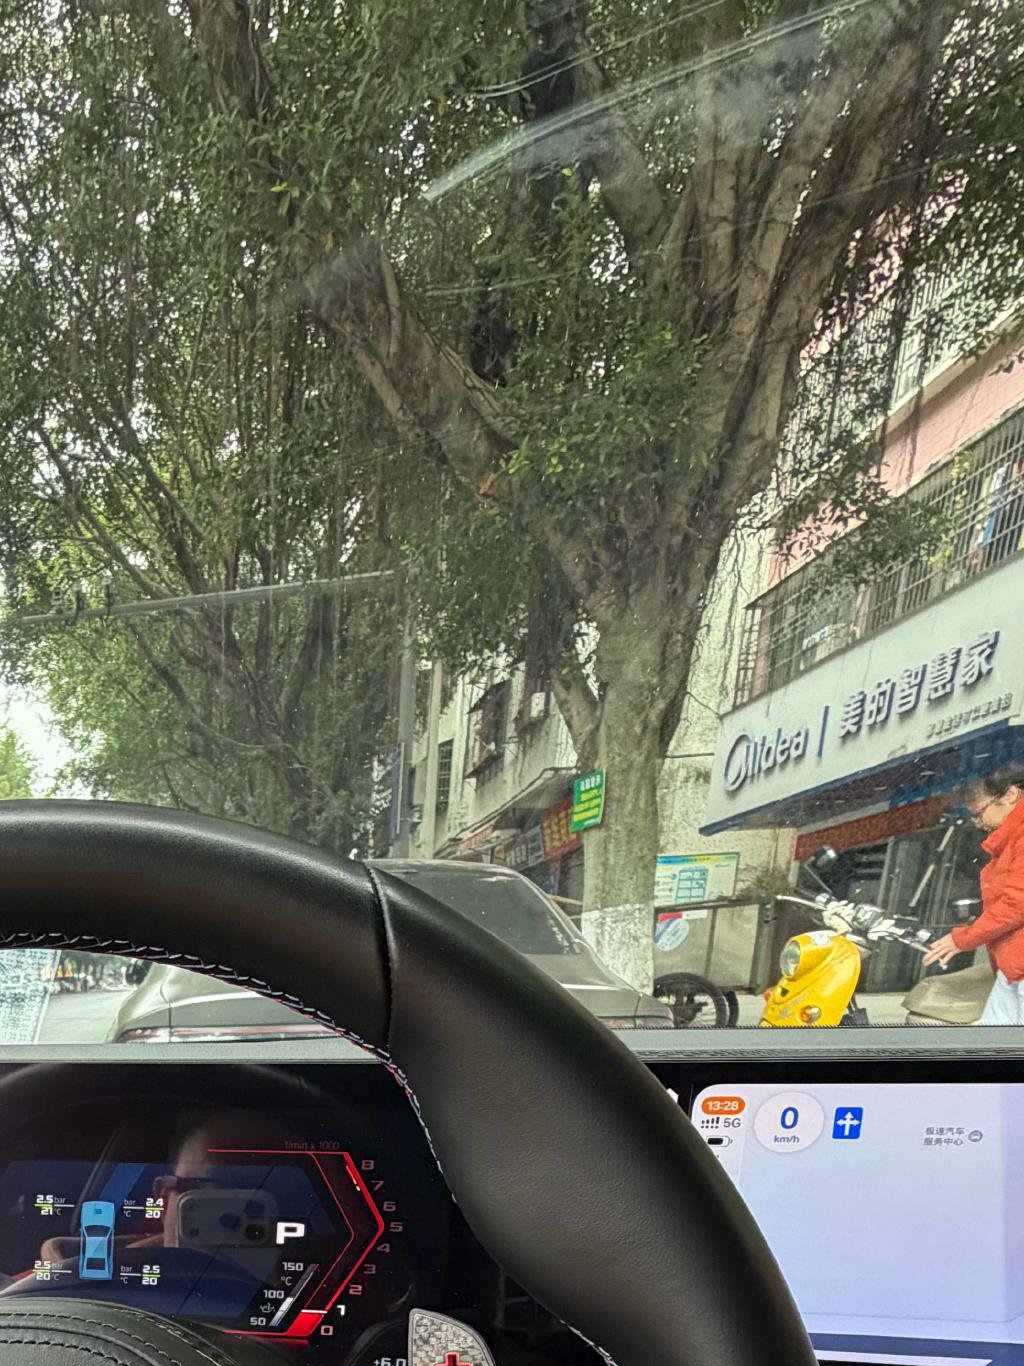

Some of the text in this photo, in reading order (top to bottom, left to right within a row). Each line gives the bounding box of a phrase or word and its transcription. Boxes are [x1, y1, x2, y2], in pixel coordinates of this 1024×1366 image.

[840, 631, 1000, 738] 美的智慧家
[724, 727, 809, 792] Midea
[706, 1101, 739, 1111] 13:28
[723, 1117, 741, 1128] 5G
[780, 1106, 799, 1129] 0
[774, 1134, 800, 1144] km/h
[923, 1137, 964, 1146] 服务中心
[361, 1159, 374, 1170] 8
[371, 1180, 384, 1191] 7
[36, 1194, 66, 1204] 2.5 bar
[145, 1198, 164, 1207] 2.4
[40, 1207, 53, 1215] 21
[383, 1201, 396, 1212] 6
[145, 1210, 161, 1219] 20
[390, 1221, 403, 1232] 5
[276, 1222, 305, 1245] P
[376, 1243, 390, 1254] 4
[34, 1260, 51, 1269] 2.5
[120, 1265, 160, 1274] bar 2.5
[282, 1262, 304, 1271] 150
[363, 1264, 376, 1274] 3
[36, 1272, 51, 1281] 20
[142, 1277, 158, 1286] 20
[263, 1289, 285, 1299] 100
[349, 1284, 362, 1295] 2
[336, 1304, 346, 1316] 1
[250, 1317, 266, 1326] 50
[320, 1325, 334, 1336] 0
